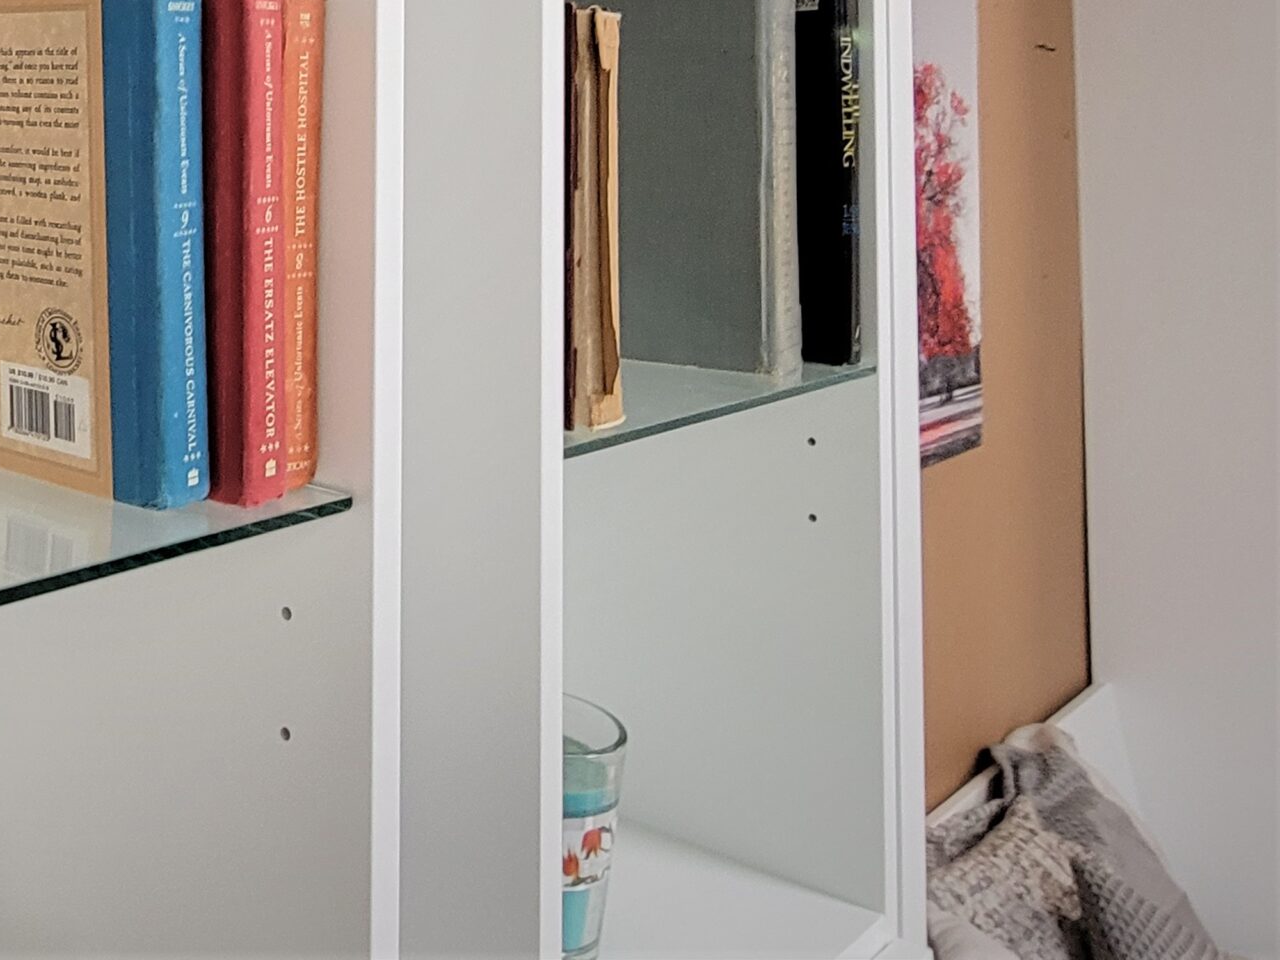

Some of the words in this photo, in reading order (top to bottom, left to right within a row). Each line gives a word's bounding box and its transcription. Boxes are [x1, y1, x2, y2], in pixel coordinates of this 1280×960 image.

[297, 51, 310, 128] HOSPITAL
[295, 133, 308, 201] HOSTILE
[180, 210, 190, 230] 9
[264, 205, 273, 224] 6
[293, 206, 306, 237] THE
[181, 239, 191, 271] THE
[263, 237, 274, 273] THE
[295, 252, 304, 270] 8
[182, 273, 195, 377] CARNIVOROUS
[263, 278, 275, 344] ERSATZ
[184, 379, 198, 452] CARNIVAL
[263, 347, 276, 438] ELEVATOR
